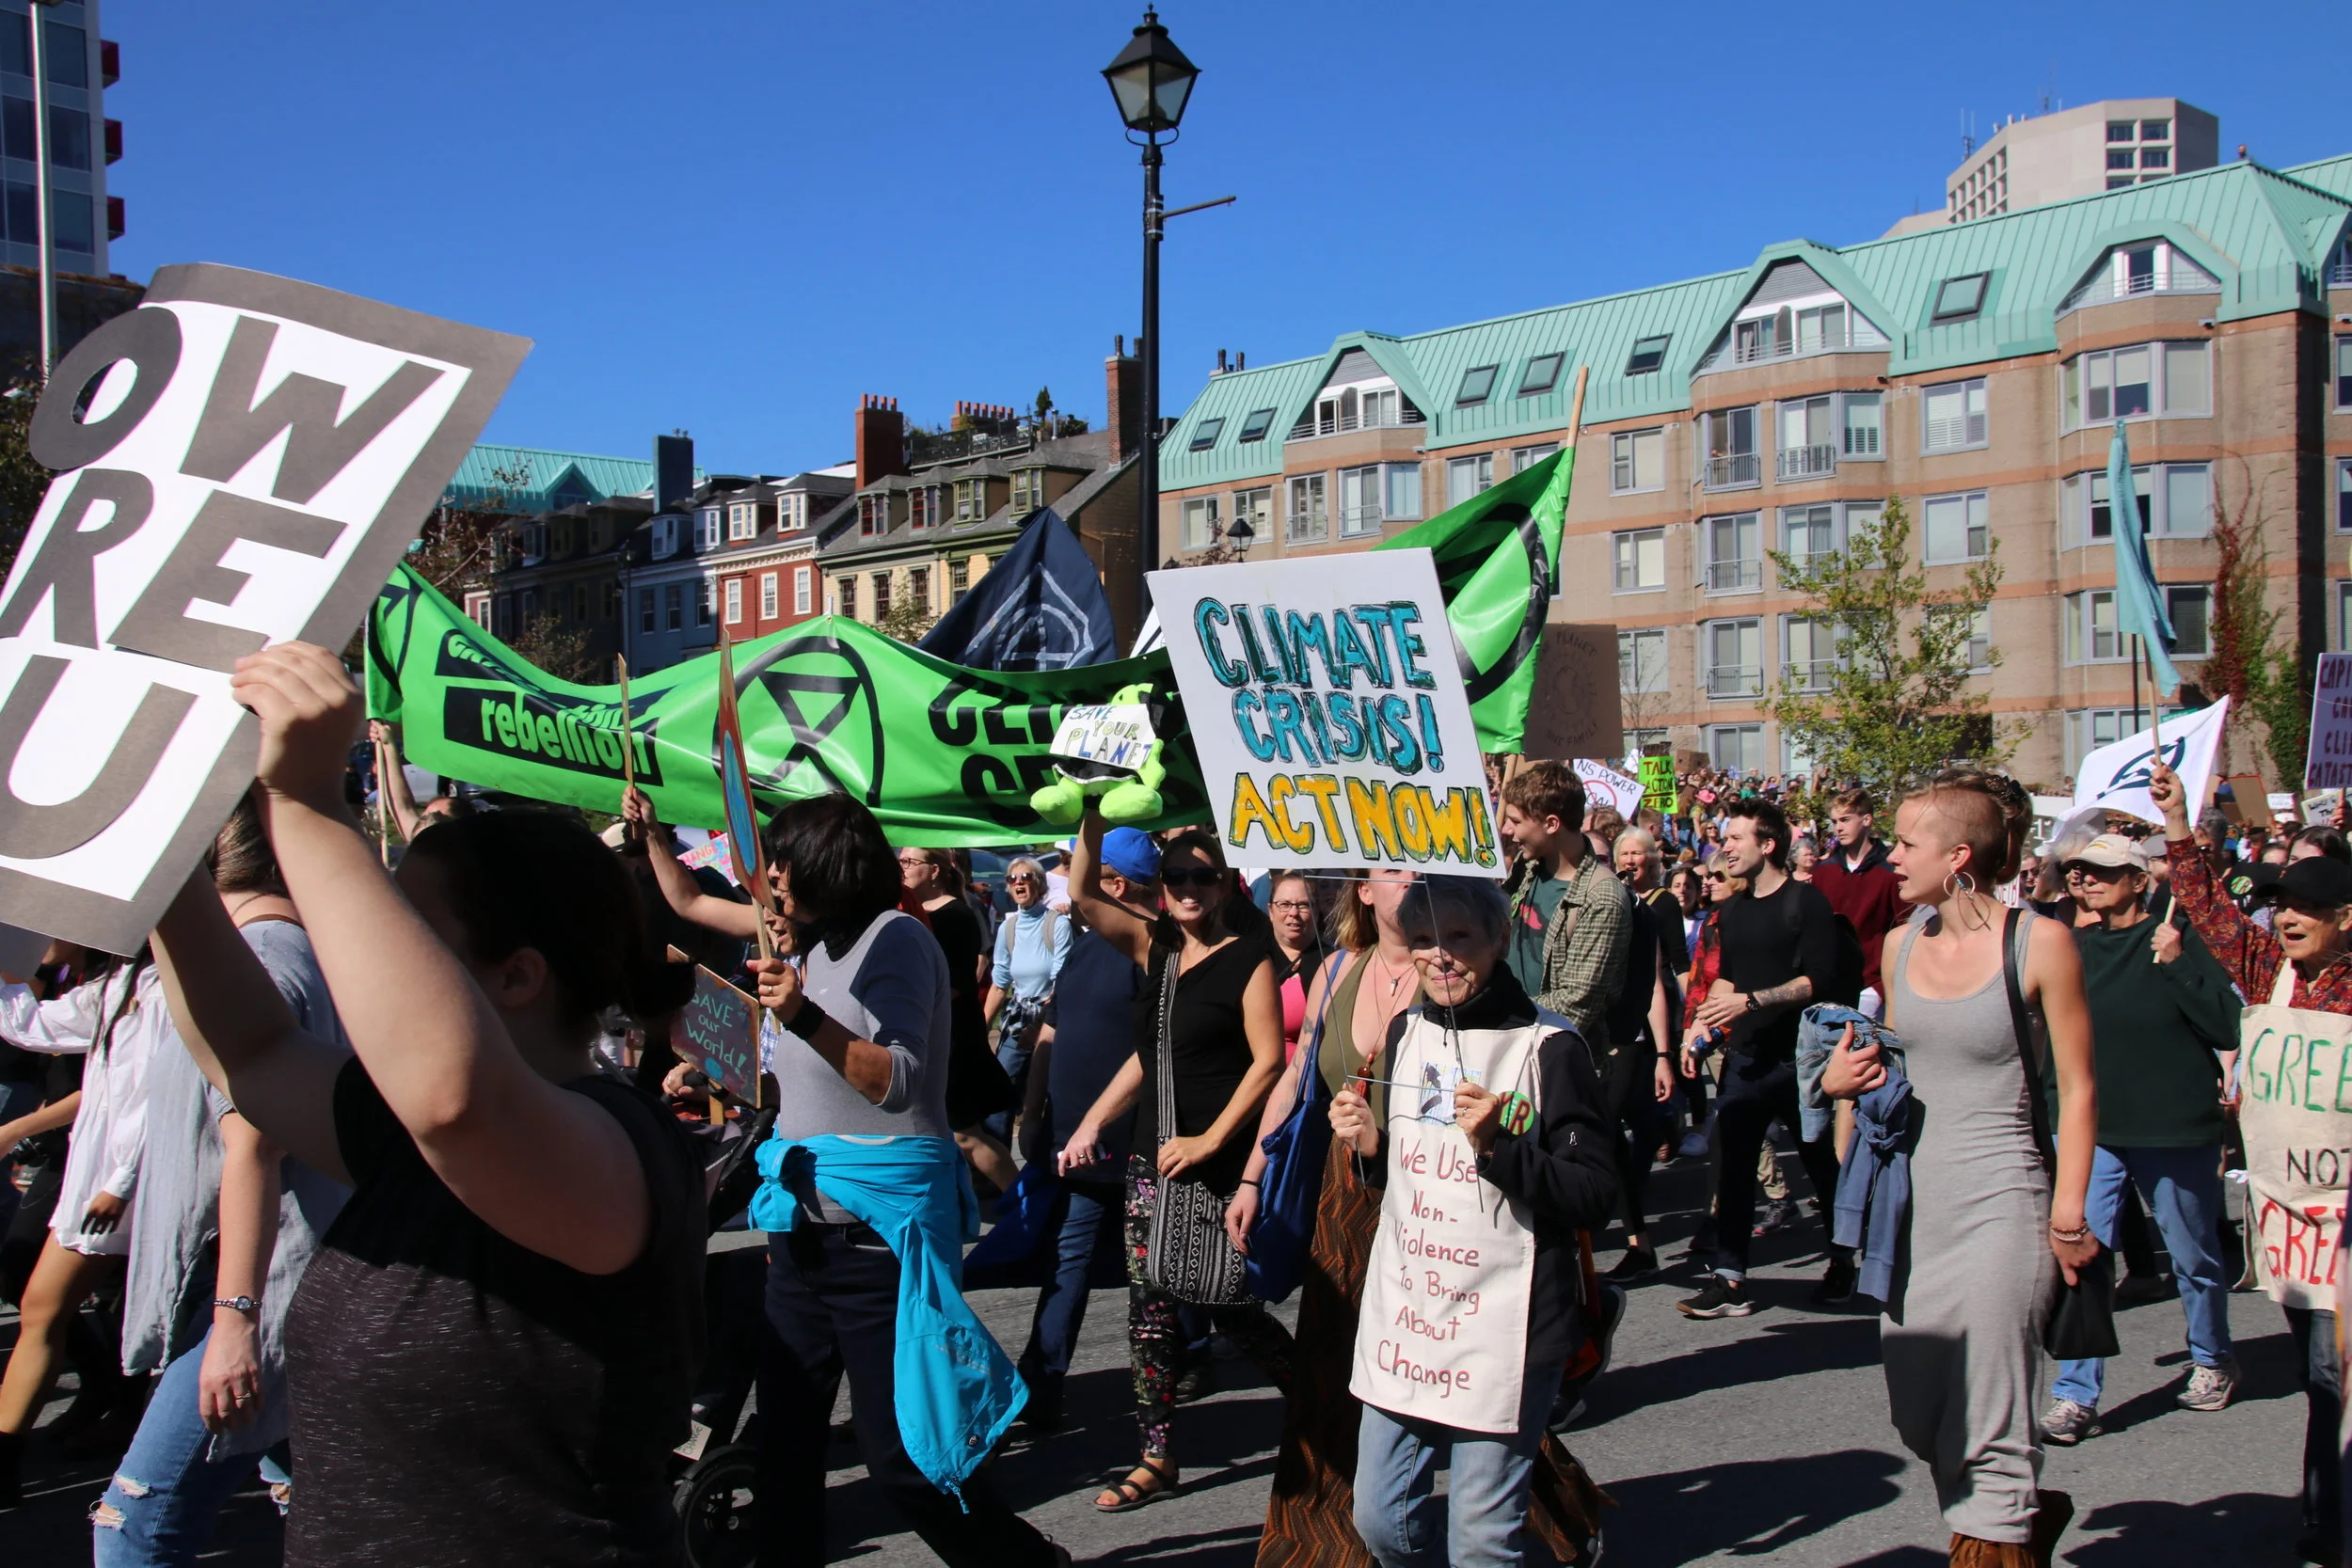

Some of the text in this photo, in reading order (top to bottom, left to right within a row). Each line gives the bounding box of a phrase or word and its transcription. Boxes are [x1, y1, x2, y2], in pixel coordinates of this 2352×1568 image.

[1194, 597, 1438, 690] CLIMATE
[1069, 705, 1117, 721] SAVE
[1093, 721, 1140, 741] YOUR
[1232, 687, 1445, 775] CRISIS!
[481, 698, 651, 775] rebellion
[1064, 727, 1152, 768] PLANET
[1598, 768, 1637, 795] POWER
[1644, 760, 1673, 775] TALK
[1584, 789, 1610, 807] OAL
[1644, 798, 1674, 809] ZERO
[1229, 772, 1497, 868] ACT NOW!
[698, 1014, 720, 1033] our
[685, 1017, 747, 1075] World!
[1400, 1137, 1478, 1183] We Use
[1411, 1190, 1458, 1222] Non-
[1394, 1219, 1480, 1268] Violence
[1425, 1270, 1481, 1316] Bring
[1394, 1306, 1461, 1341] About
[1377, 1339, 1471, 1399] Change
